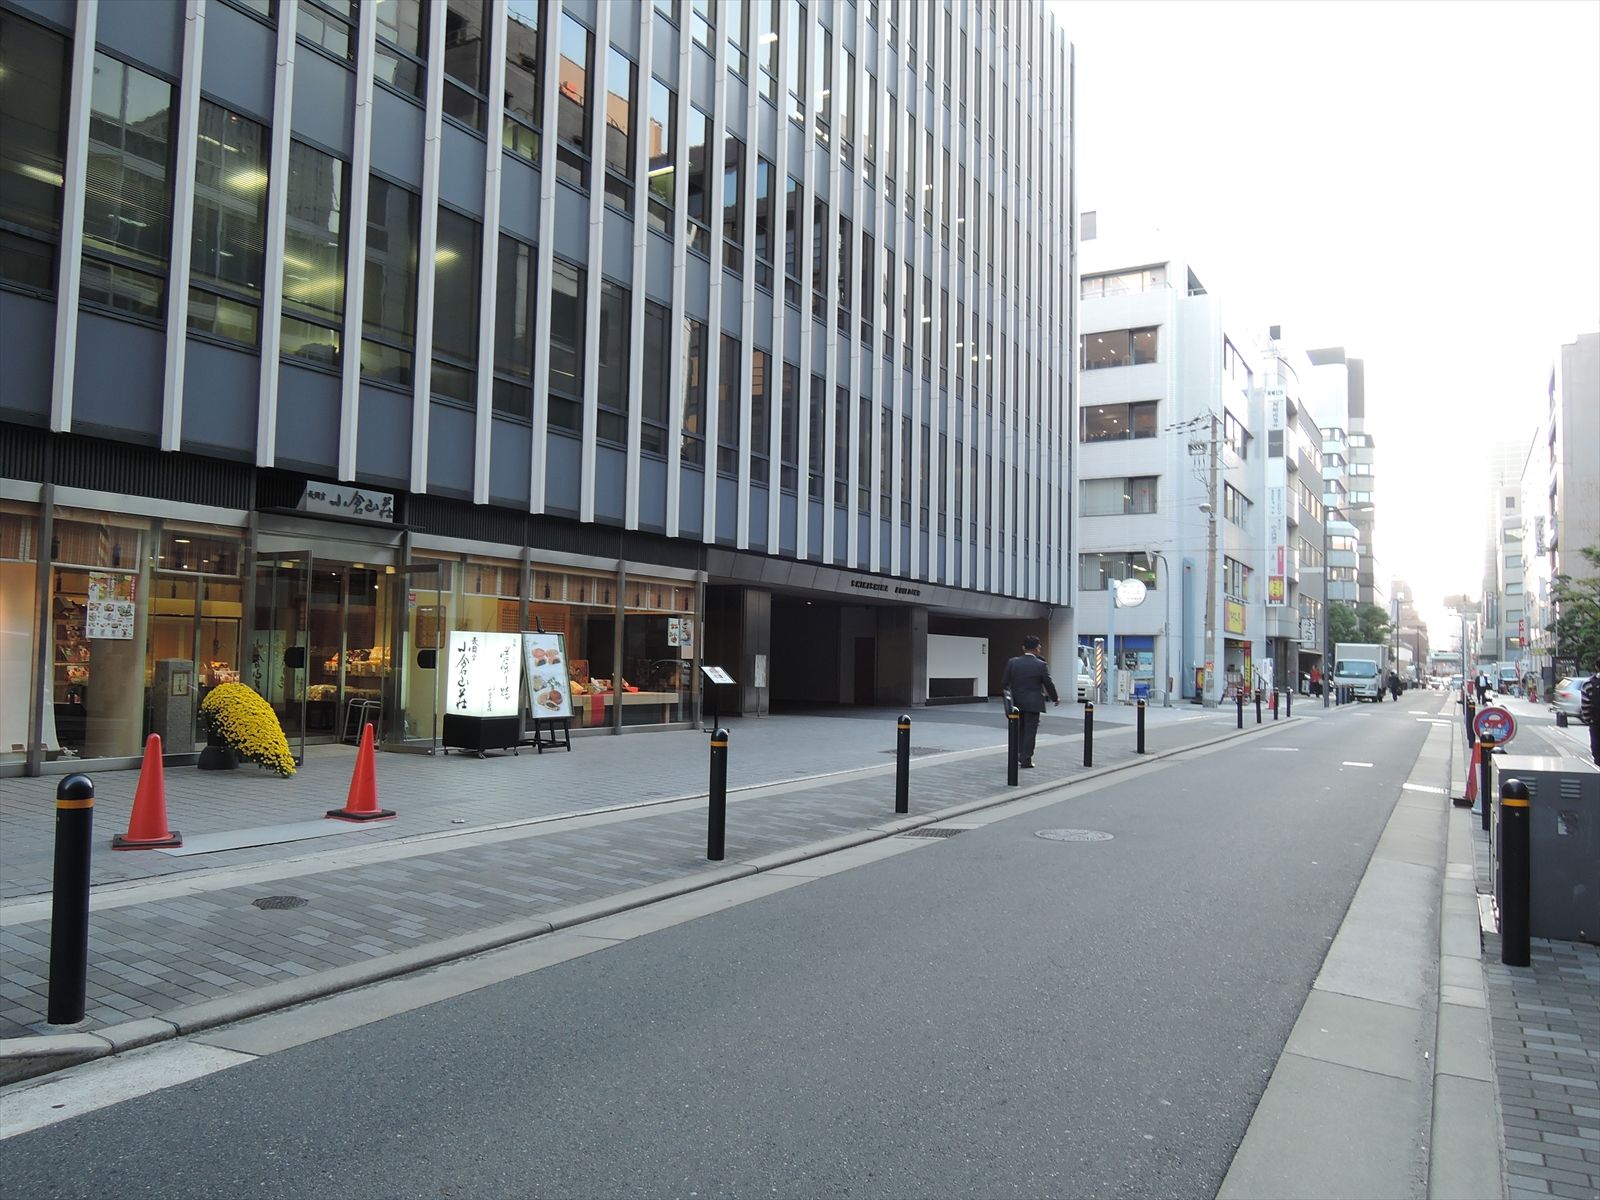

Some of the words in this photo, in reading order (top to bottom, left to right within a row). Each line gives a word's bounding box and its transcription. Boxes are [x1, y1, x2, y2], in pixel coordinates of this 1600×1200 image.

[329, 490, 393, 519] 小倉山荘
[456, 641, 471, 710] 小倉山荘
